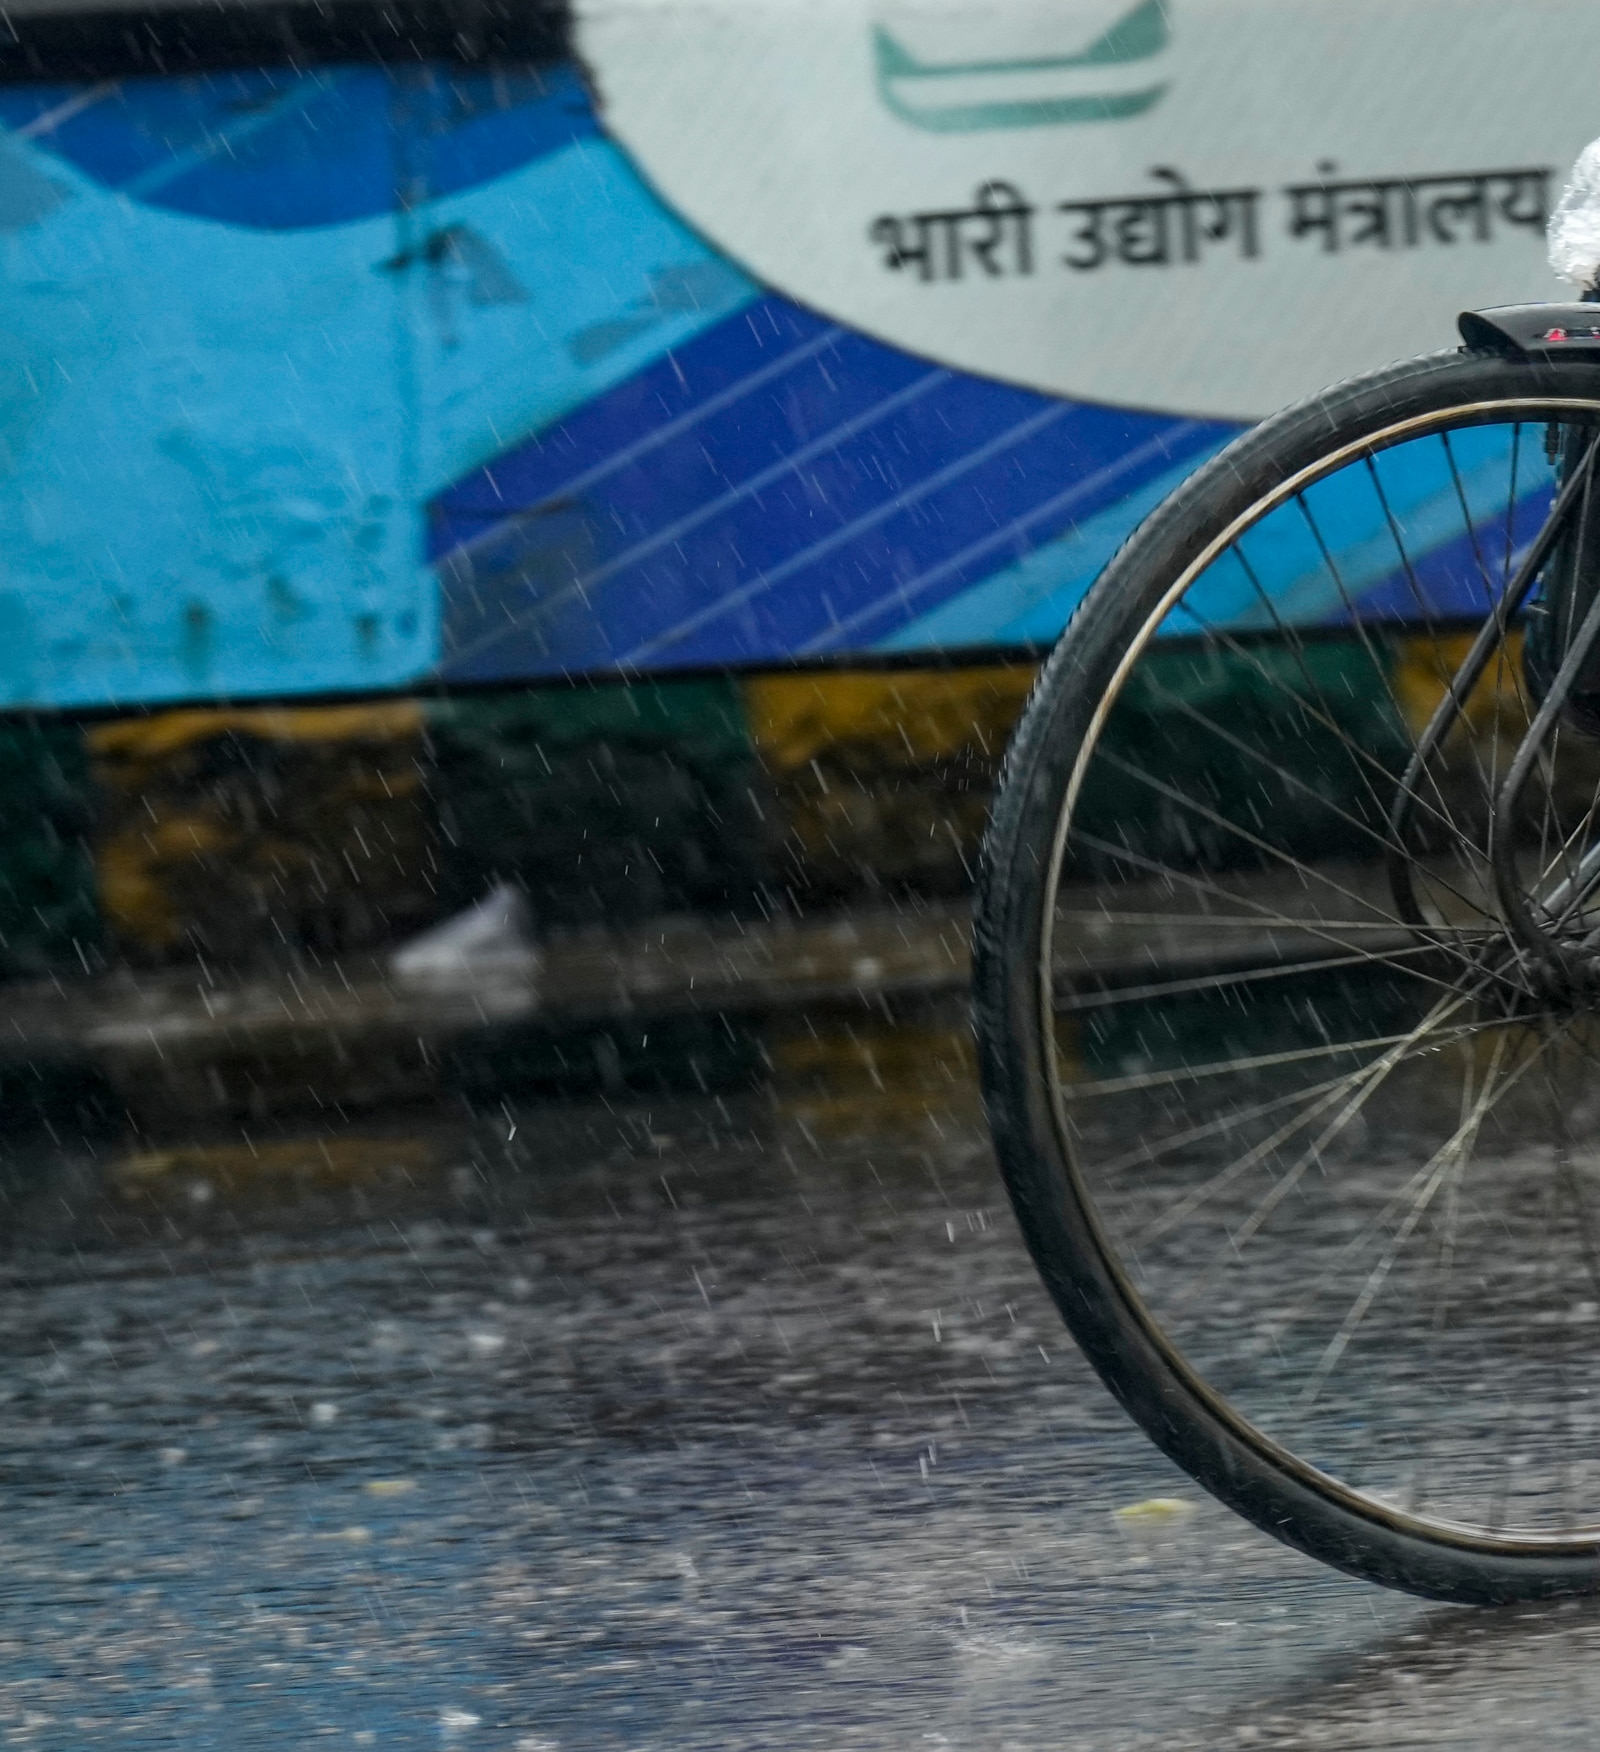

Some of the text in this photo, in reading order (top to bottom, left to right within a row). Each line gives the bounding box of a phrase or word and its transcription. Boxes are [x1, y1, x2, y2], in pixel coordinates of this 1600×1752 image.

[870, 157, 1555, 283] भारी उद्योग मंत्रालय
